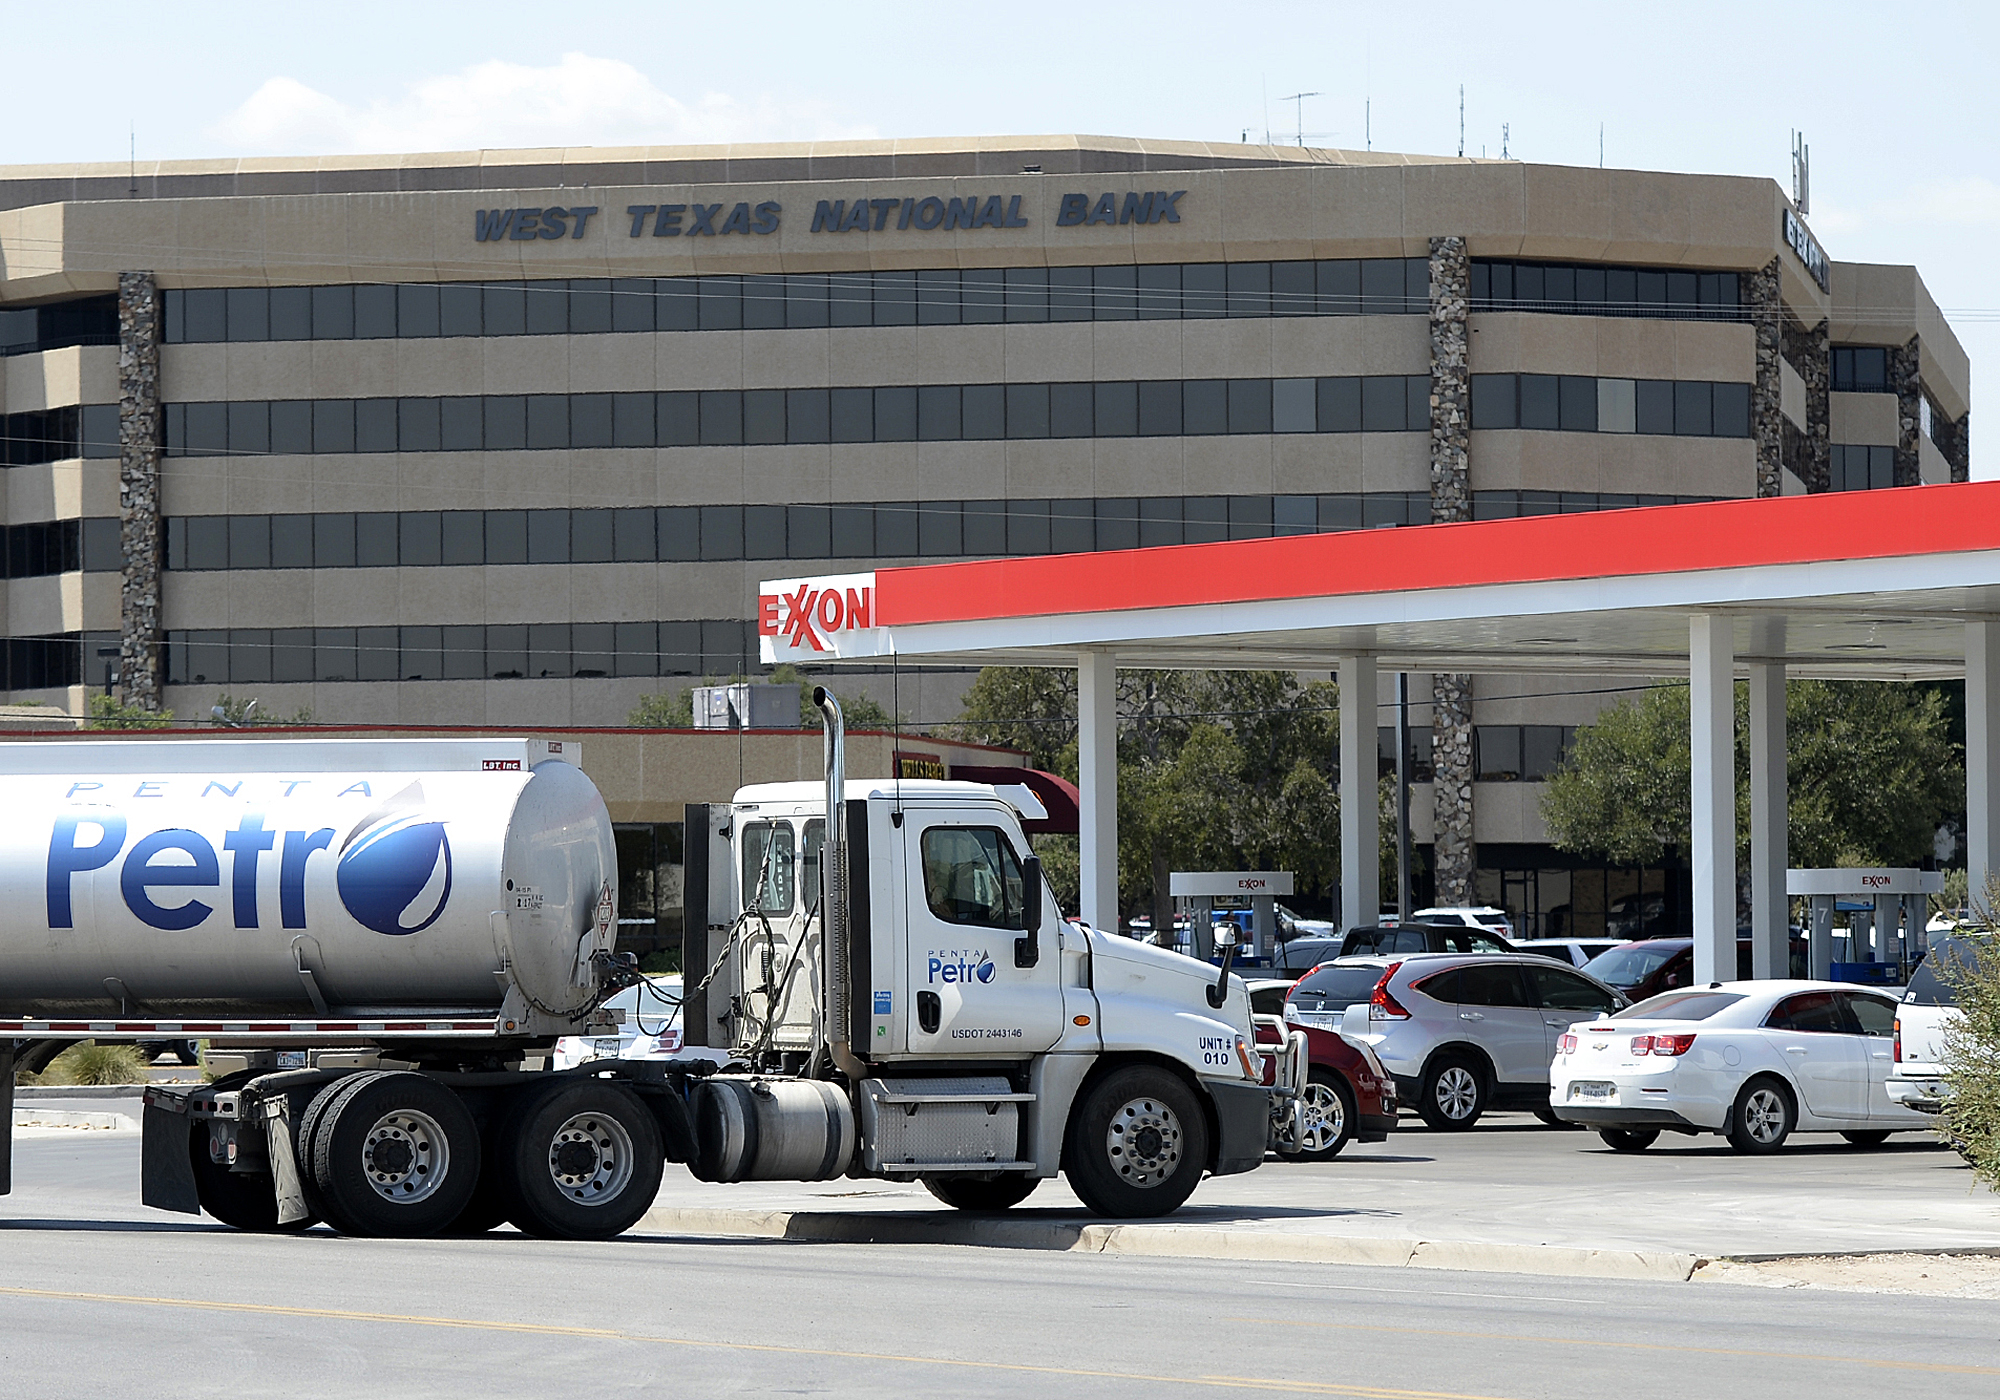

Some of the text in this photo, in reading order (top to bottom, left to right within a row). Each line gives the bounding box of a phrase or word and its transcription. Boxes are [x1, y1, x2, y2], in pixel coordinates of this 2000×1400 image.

[475, 190, 1188, 243] WEST TEXAS NATIONAL BANK
[758, 584, 871, 652] EXXON
[502, 761, 520, 771] Inc.
[66, 780, 372, 798] PENTA
[46, 800, 453, 937] Petro
[1238, 878, 1266, 890] EXXON
[1862, 875, 1891, 888] EXXON
[1195, 908, 1209, 923] 11
[1819, 908, 1829, 923] 7
[928, 949, 981, 958] PENTA
[928, 957, 996, 984] Petro
[951, 1028, 1023, 1039] USDOT 2443146
[1199, 1036, 1223, 1050] UNIT
[1204, 1052, 1229, 1066] 010
